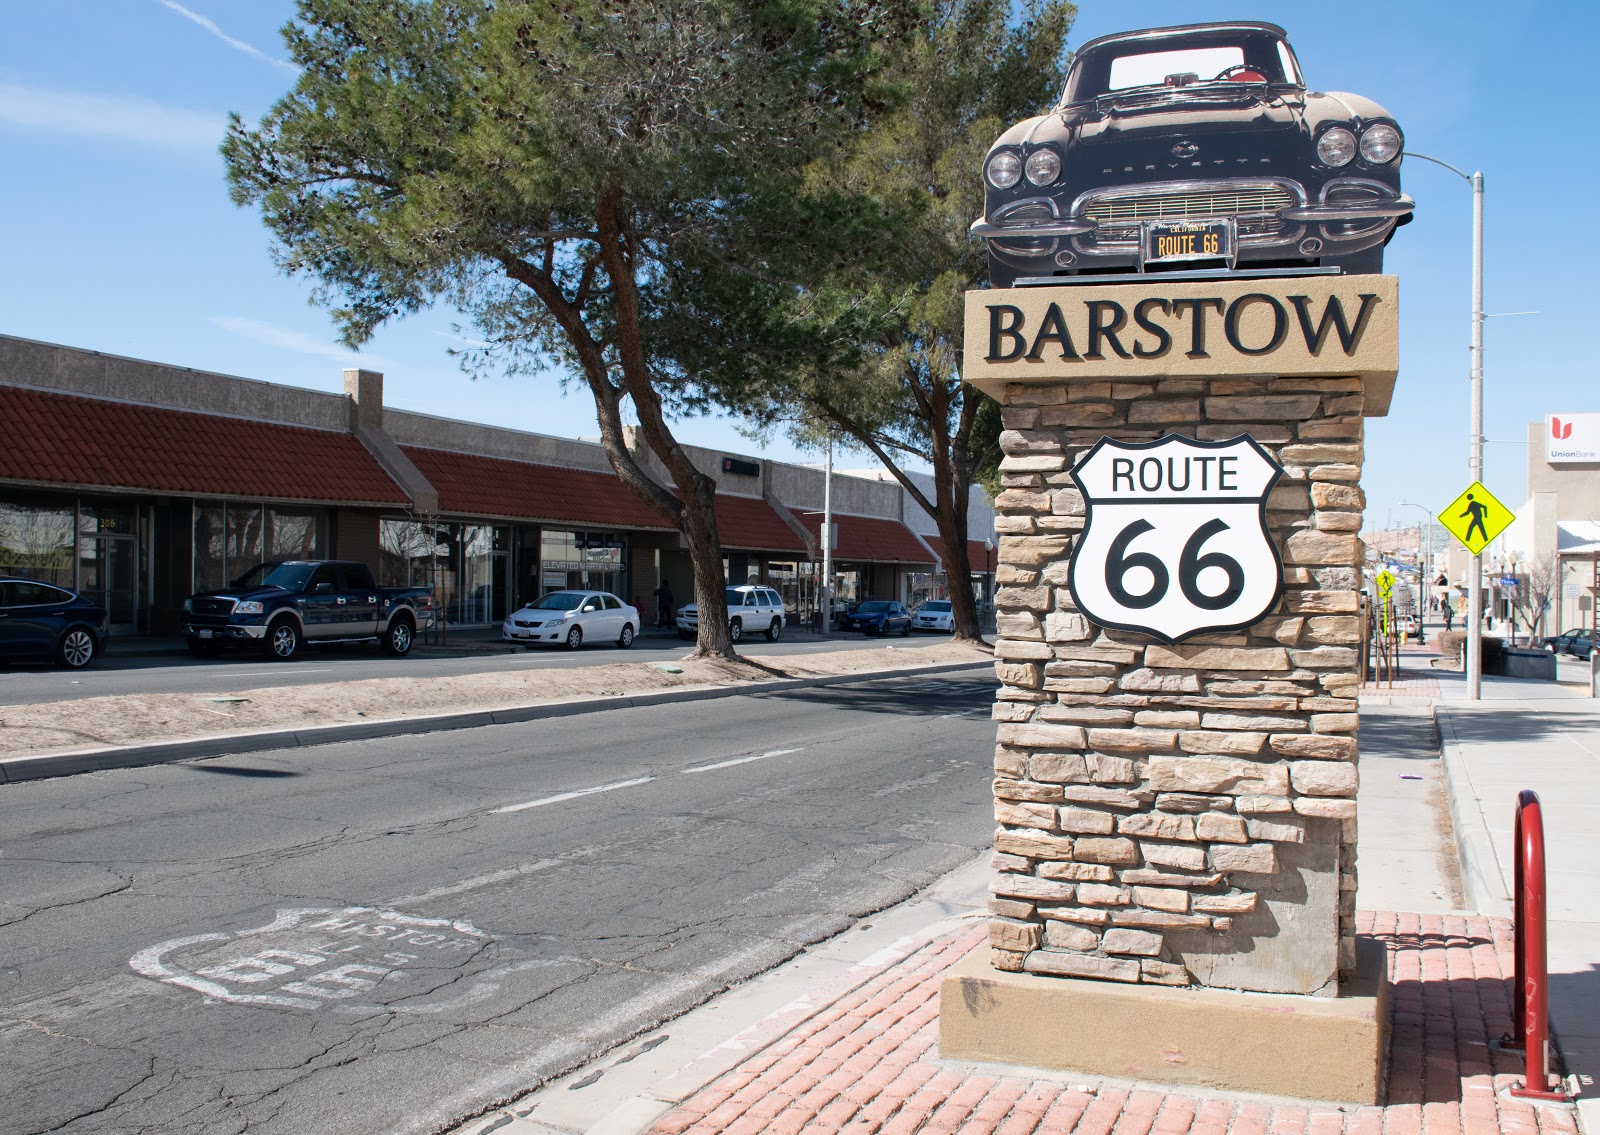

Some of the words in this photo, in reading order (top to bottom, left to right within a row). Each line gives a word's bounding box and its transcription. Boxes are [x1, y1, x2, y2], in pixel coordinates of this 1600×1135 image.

[1158, 235, 1196, 256] ROUTE
[1203, 234, 1218, 253] 66
[984, 293, 1378, 361] BARSTOW
[1112, 456, 1239, 492] ROUTE
[100, 518, 116, 528] 308
[543, 561, 579, 570] ELEVATED
[579, 562, 609, 570] MARTIAL
[609, 563, 625, 571] ARTS
[1105, 518, 1245, 611] 66
